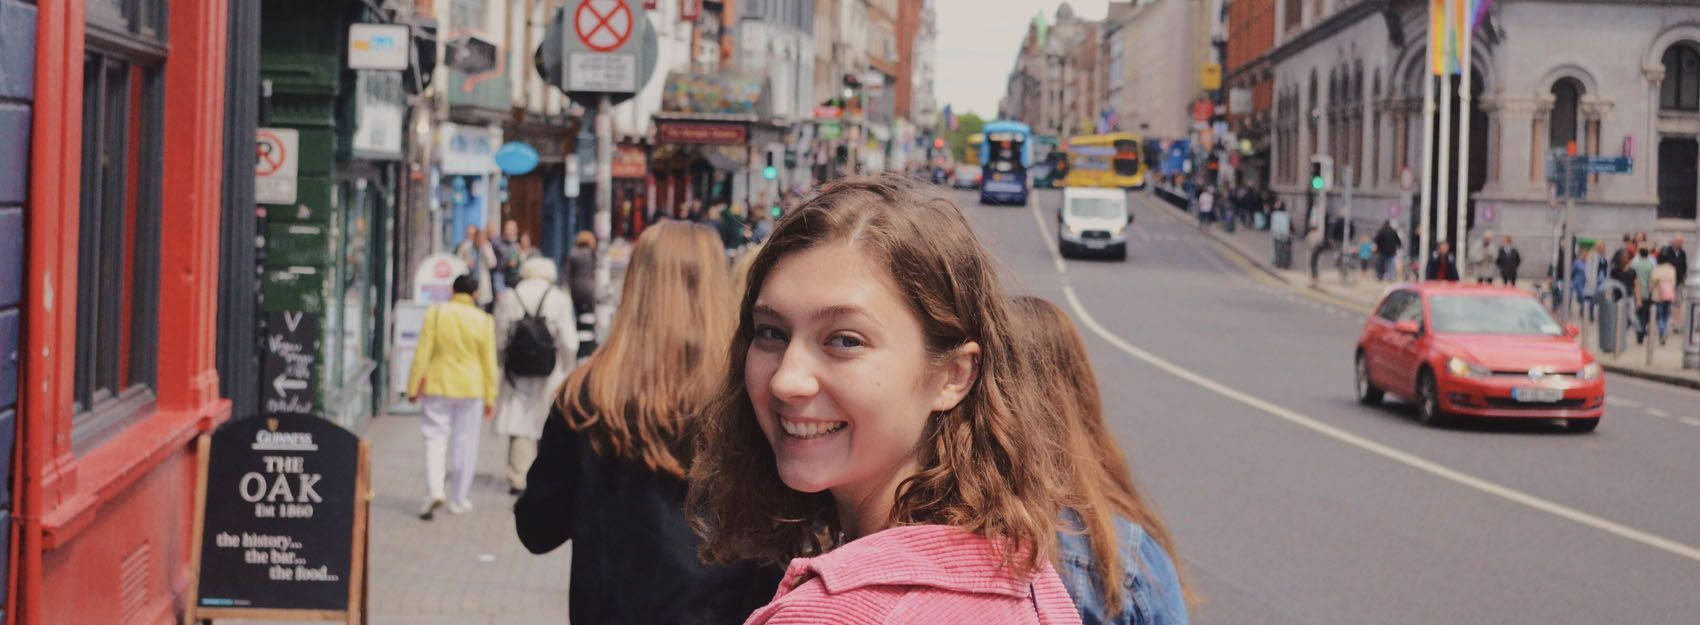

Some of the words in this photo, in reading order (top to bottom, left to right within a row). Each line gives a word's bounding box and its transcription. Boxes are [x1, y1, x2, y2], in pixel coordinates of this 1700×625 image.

[262, 456, 304, 473] THE
[239, 472, 323, 503] OAK
[216, 531, 240, 548] the
[245, 548, 269, 564] the
[269, 564, 294, 580] the
